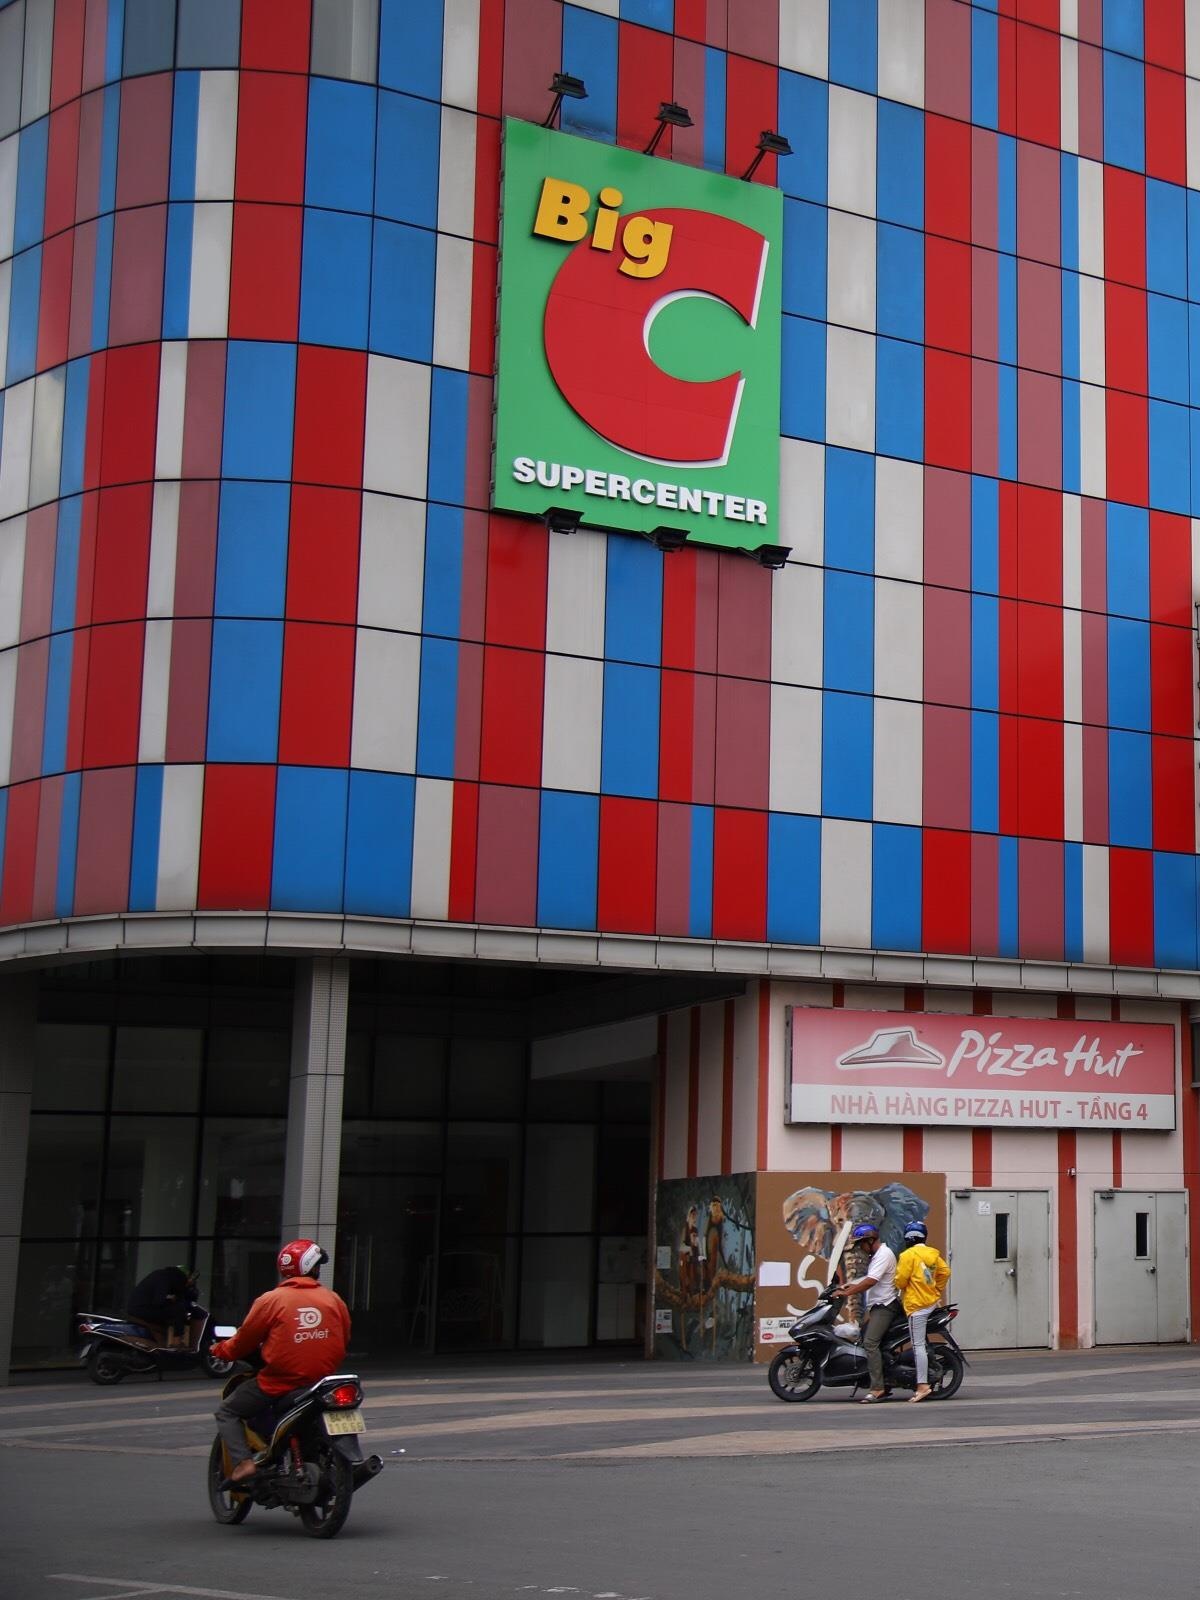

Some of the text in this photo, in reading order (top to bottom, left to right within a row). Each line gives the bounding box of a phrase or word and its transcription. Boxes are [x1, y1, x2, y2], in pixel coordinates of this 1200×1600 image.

[533, 177, 769, 467] Big C
[513, 457, 768, 525] SUPERCENTER
[946, 1029, 1144, 1077] Pizza Hut
[830, 1091, 879, 1116] NHÀ
[885, 1092, 949, 1117] HÀNG
[954, 1098, 1018, 1118] PIZZA
[1020, 1100, 1062, 1119] HUT
[1077, 1096, 1132, 1121] TẦNG
[1136, 1102, 1149, 1120] 4
[294, 1329, 329, 1343] goviet
